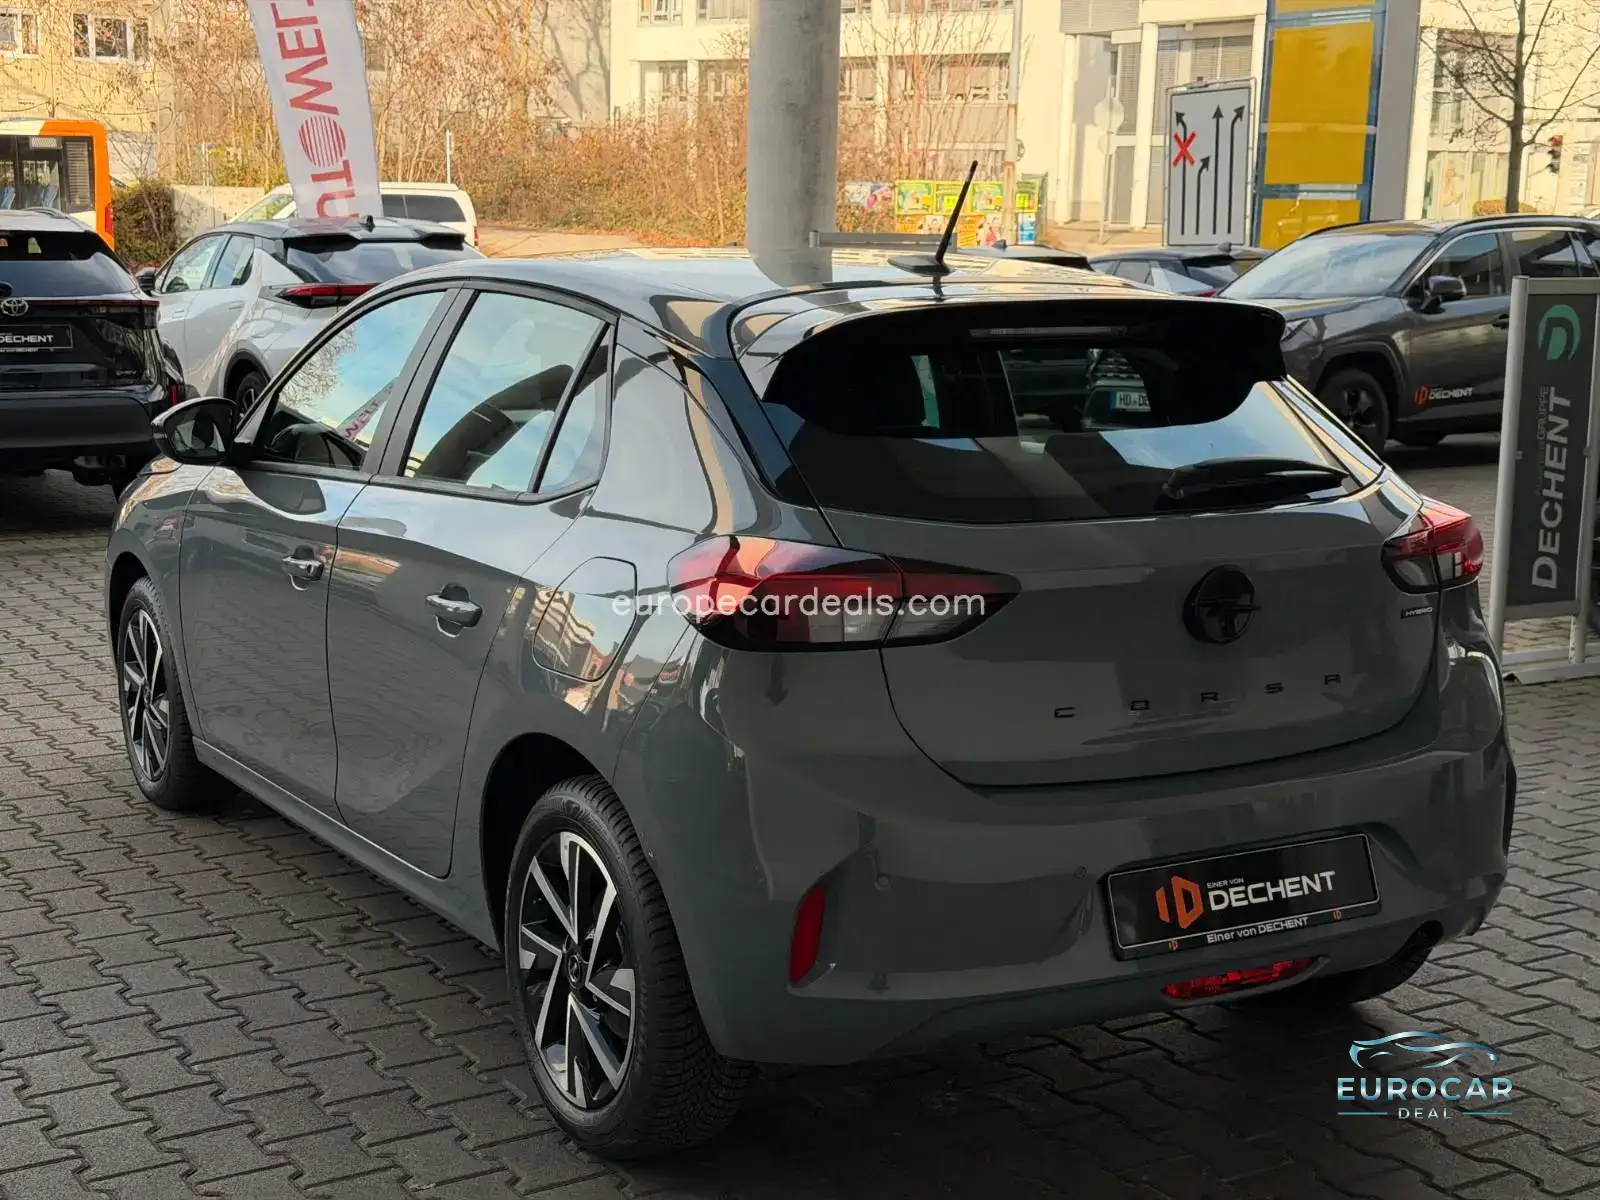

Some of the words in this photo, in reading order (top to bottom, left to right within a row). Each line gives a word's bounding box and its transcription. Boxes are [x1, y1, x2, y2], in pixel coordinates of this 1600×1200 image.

[1531, 386, 1571, 590] DECHENT
[1054, 673, 1341, 719] CORSA
[1206, 879, 1229, 889] EINER
[1229, 877, 1244, 887] VON
[1208, 870, 1336, 912] DECHENT
[1206, 930, 1237, 944] Einer
[1237, 927, 1257, 939] von
[1258, 916, 1309, 935] DECHENT
